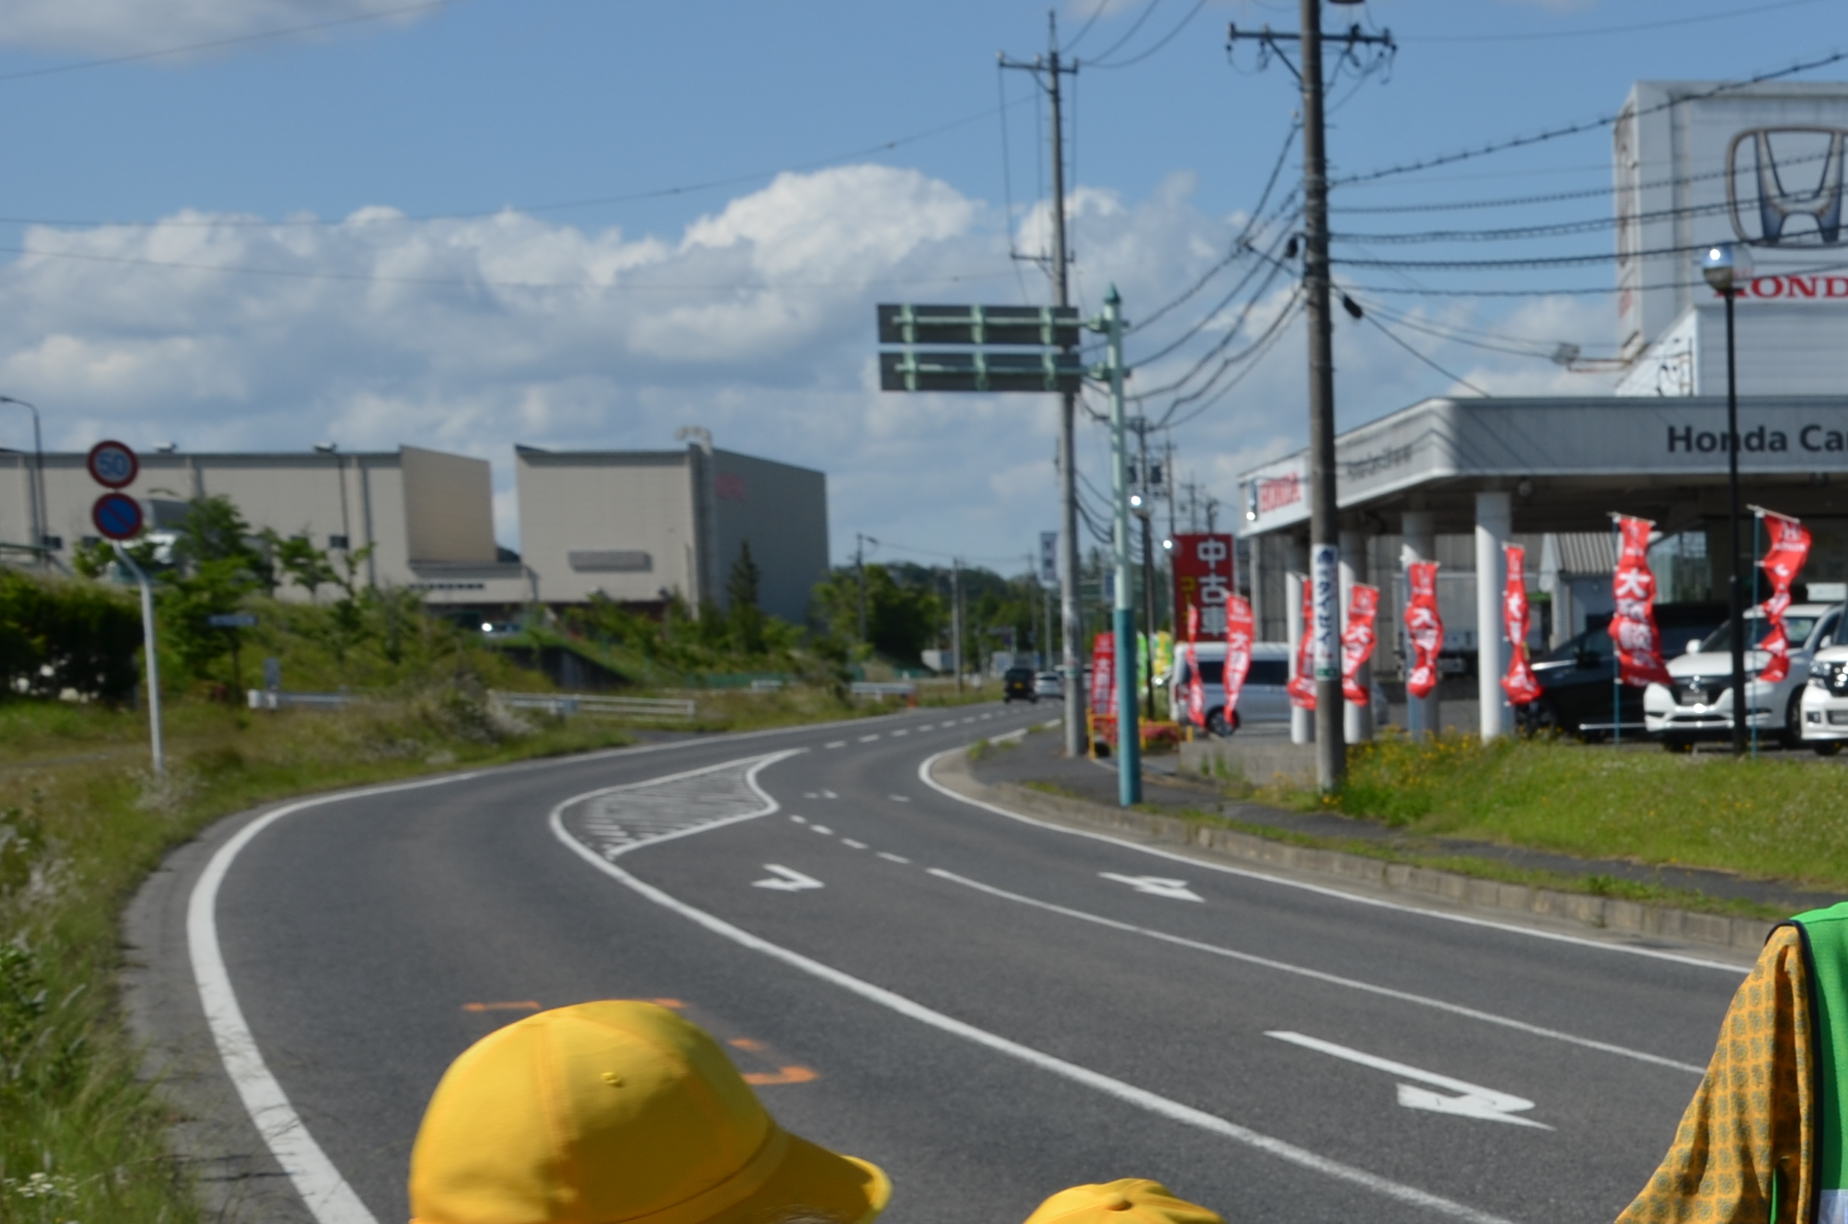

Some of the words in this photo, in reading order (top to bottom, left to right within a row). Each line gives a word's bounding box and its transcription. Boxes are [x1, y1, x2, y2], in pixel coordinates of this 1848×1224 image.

[1666, 424, 1788, 453] Honda
[1196, 537, 1229, 637] 中古車
